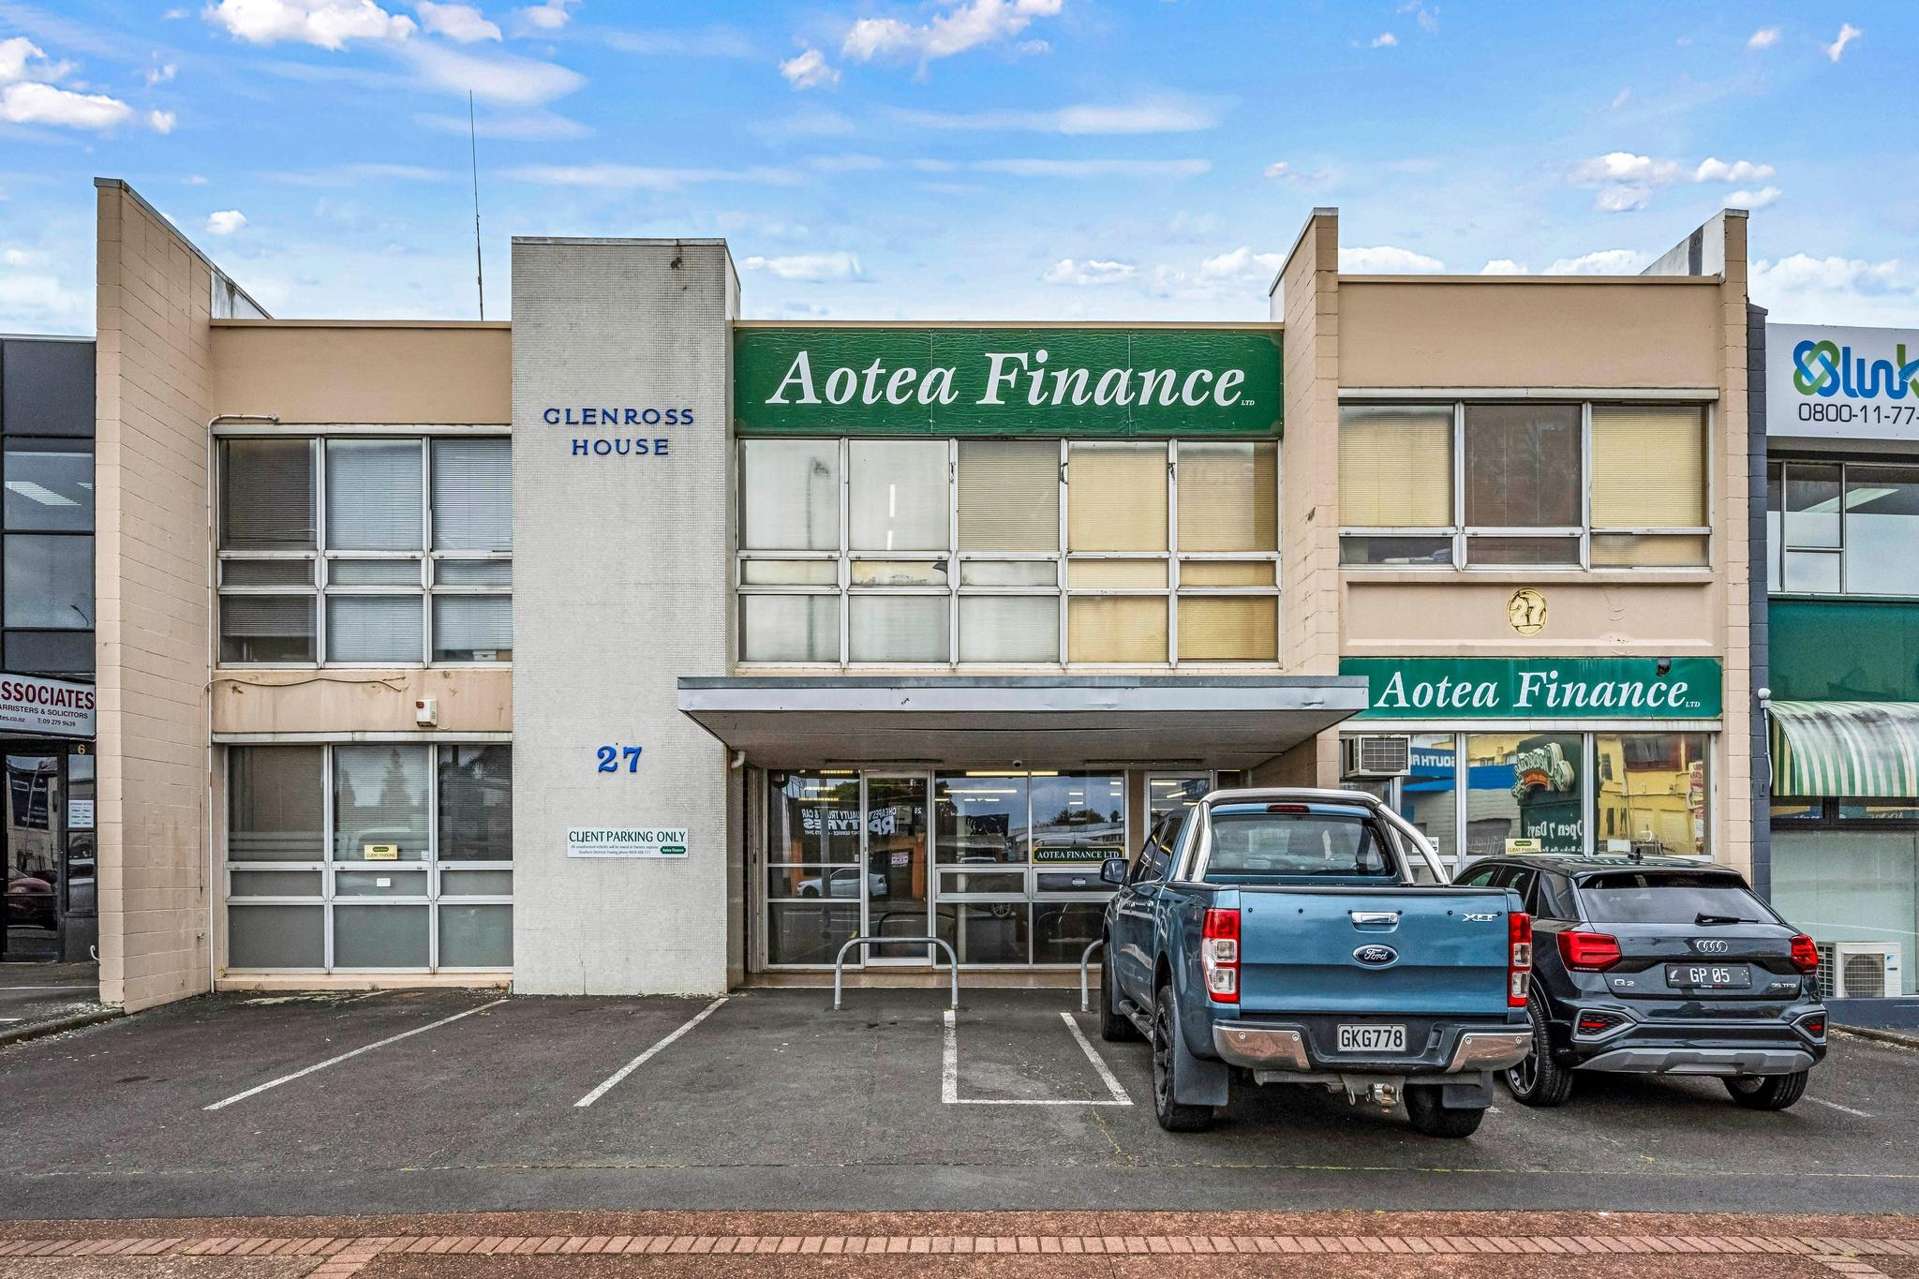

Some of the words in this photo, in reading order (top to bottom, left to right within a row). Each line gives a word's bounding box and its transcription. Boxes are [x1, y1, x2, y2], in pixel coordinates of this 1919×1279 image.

[766, 350, 959, 406] Aotea
[976, 349, 1246, 408] Finance
[543, 408, 694, 425] GLENROSS
[572, 439, 669, 456] HOUSE
[1374, 671, 1500, 708] Aotea
[1513, 670, 1689, 708] Finance
[1685, 700, 1701, 708] LTD
[47, 709, 89, 720] SOLICITORS
[77, 744, 86, 754] 6
[597, 745, 642, 773] 27
[569, 830, 605, 843] CLIENT
[606, 830, 654, 843] PARKING
[656, 830, 686, 843] ONLY
[1037, 850, 1065, 859] AOTEA
[1066, 850, 1102, 859] FINANCE
[1103, 850, 1120, 859] LTD
[1363, 947, 1389, 961] Ford
[1614, 978, 1635, 987] Q2
[1689, 968, 1708, 983] GP
[1711, 968, 1730, 983] 05
[1341, 1029, 1403, 1048] GKG778
